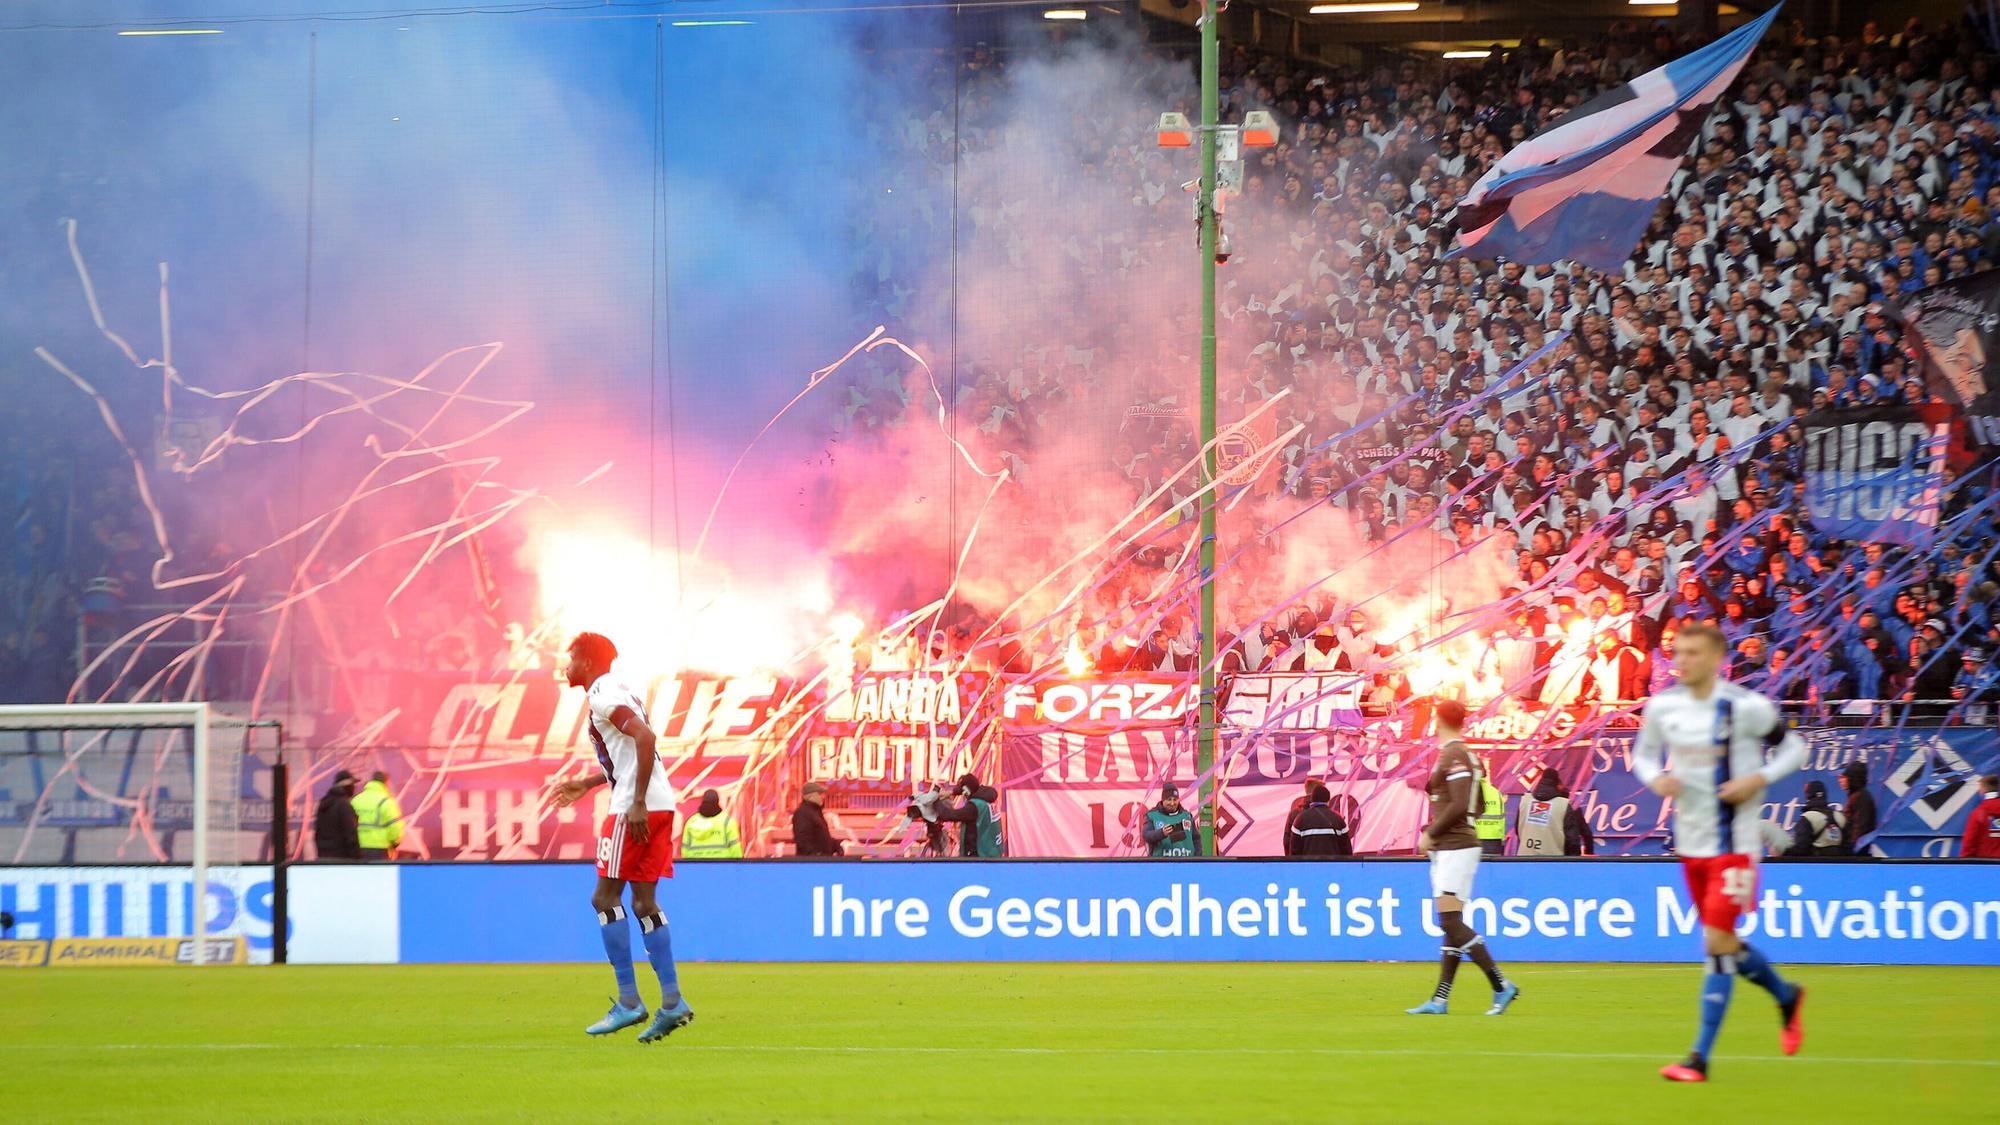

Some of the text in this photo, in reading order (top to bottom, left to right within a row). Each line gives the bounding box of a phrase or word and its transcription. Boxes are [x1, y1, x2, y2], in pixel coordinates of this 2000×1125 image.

[1526, 838, 1542, 850] 02
[813, 884, 929, 937] Ihre
[948, 883, 1307, 938] Gesundheit
[1326, 883, 1402, 937] ist
